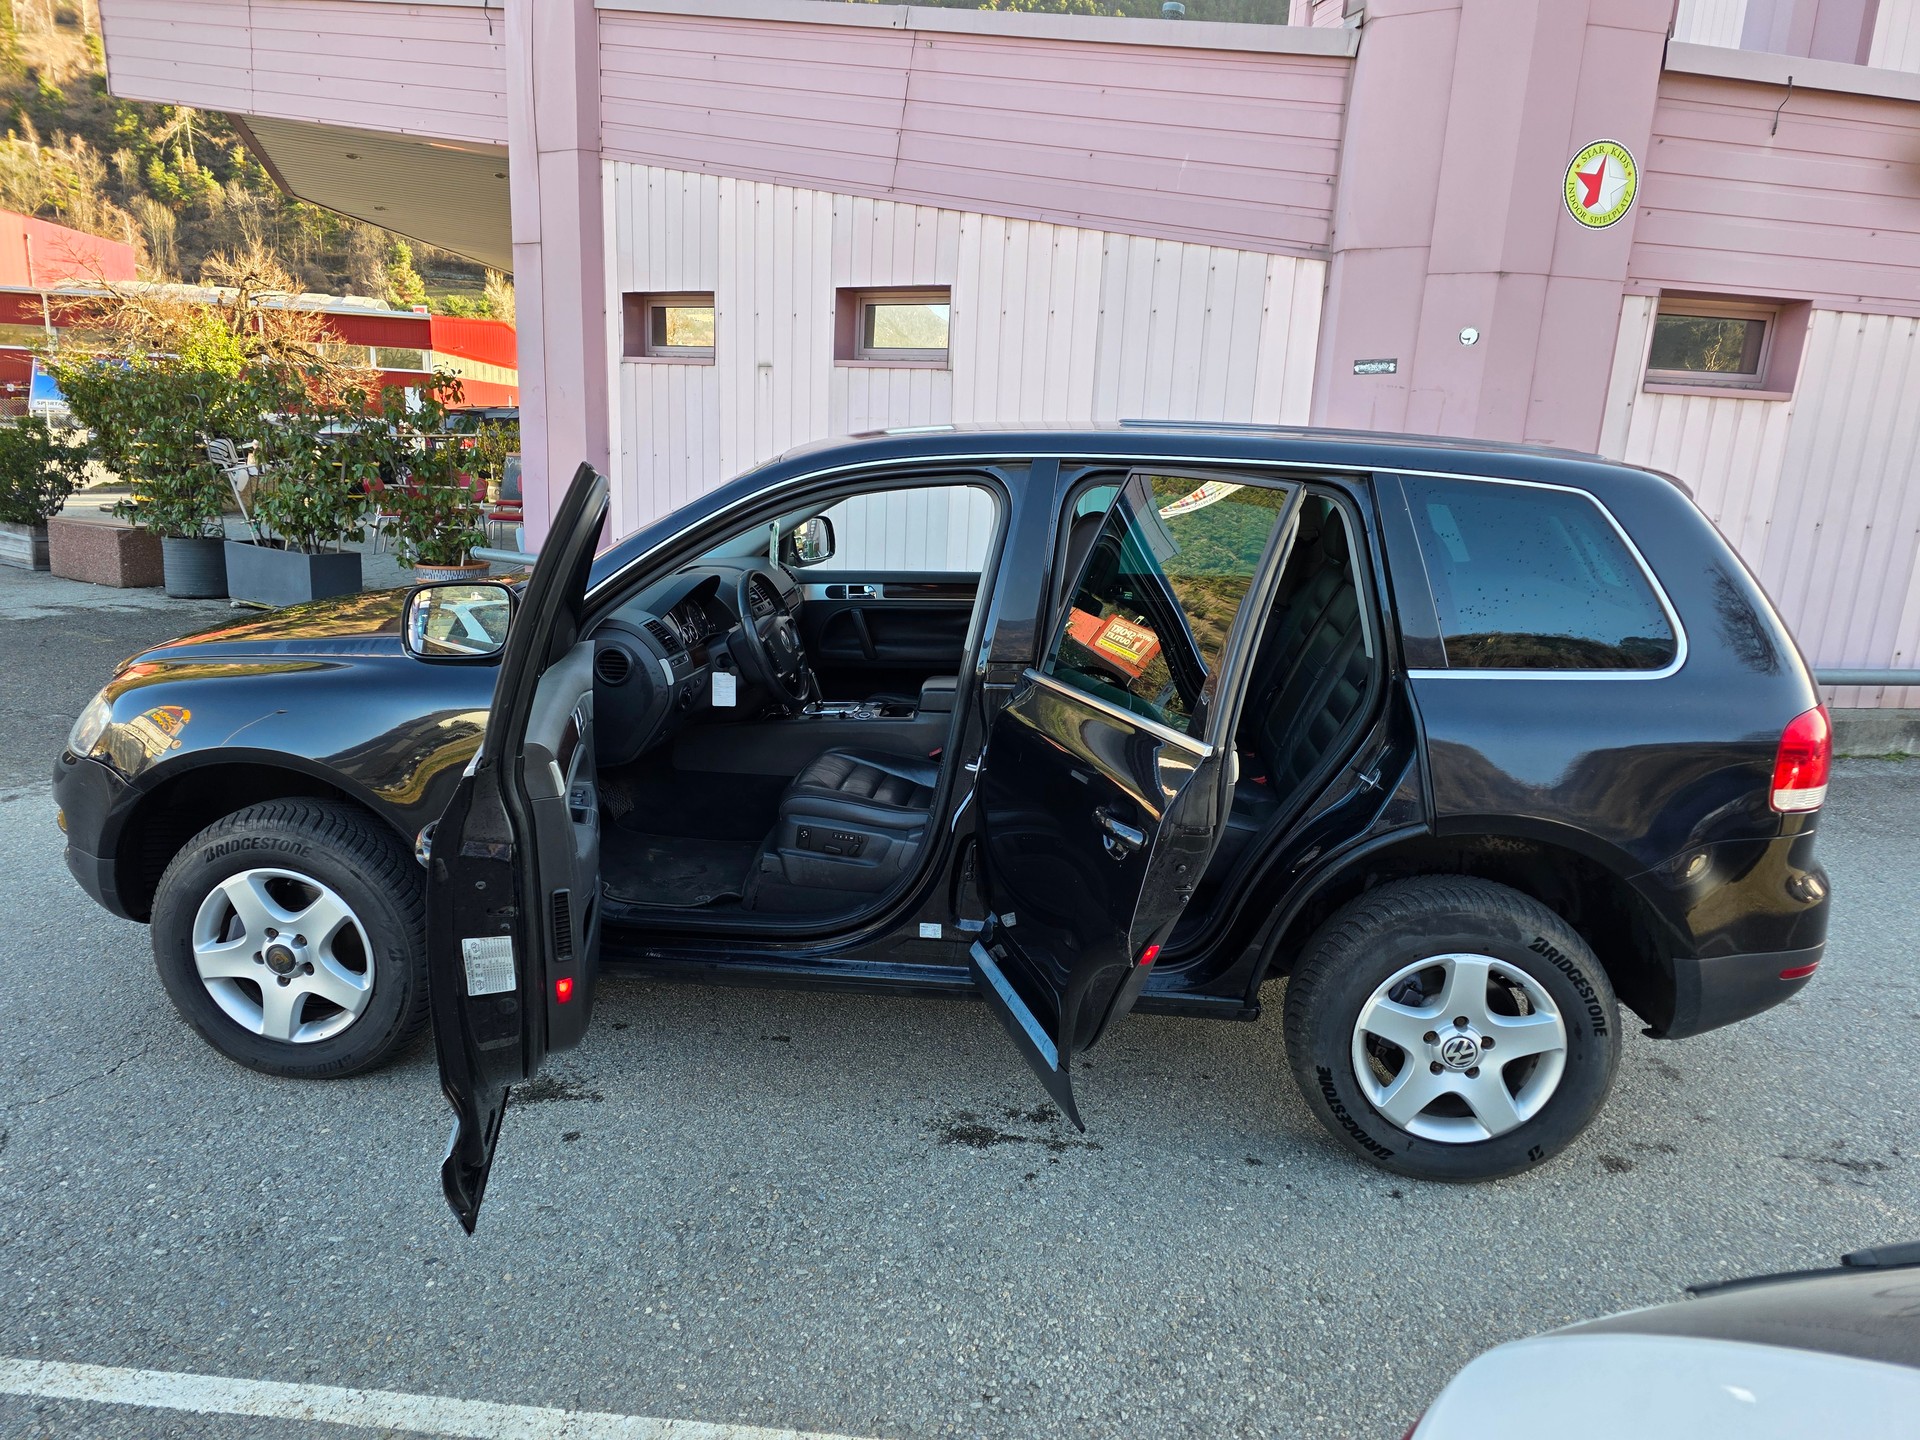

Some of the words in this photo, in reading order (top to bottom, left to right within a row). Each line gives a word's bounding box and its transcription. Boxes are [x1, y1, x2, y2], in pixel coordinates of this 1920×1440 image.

[1581, 146, 1605, 162] STAR
[1610, 147, 1631, 169] KIDS
[1568, 182, 1587, 220] INDOOR
[1589, 190, 1632, 224] SPIELPLATZ
[203, 837, 313, 863] BRIDGESTONE
[1528, 936, 1608, 1037] BRIDGESTONE
[1316, 1065, 1396, 1161] BRIDGESTONE
